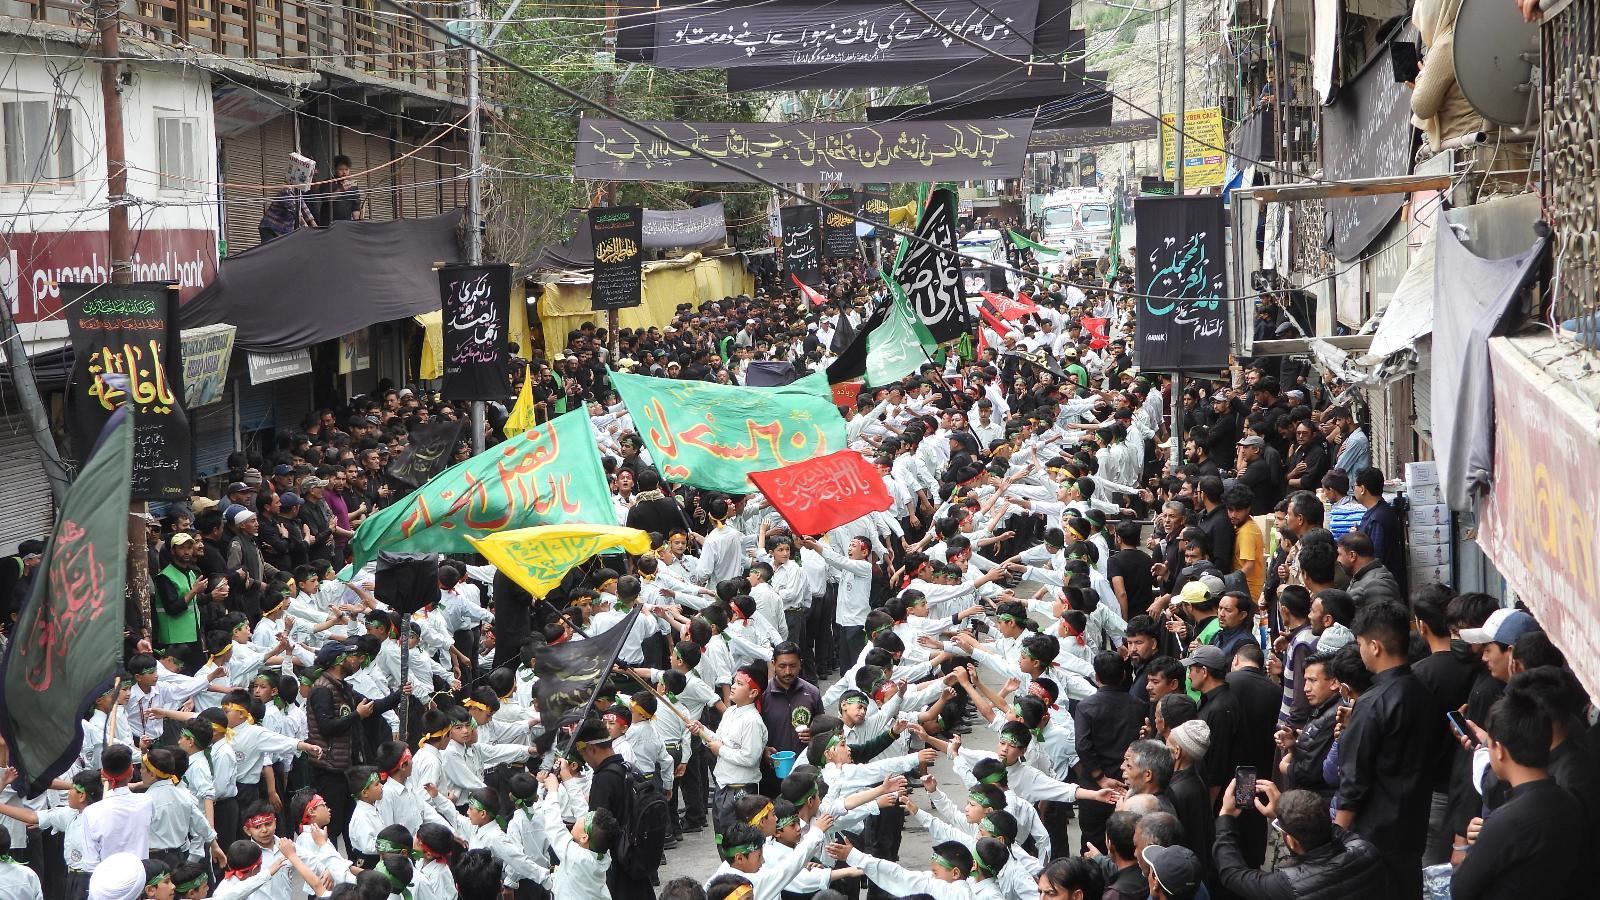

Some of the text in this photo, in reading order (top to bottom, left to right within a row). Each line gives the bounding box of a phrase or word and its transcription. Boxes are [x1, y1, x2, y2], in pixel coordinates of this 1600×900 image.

[838, 19, 879, 45] طاقت
[877, 12, 906, 49] کی
[174, 250, 204, 287] bank
